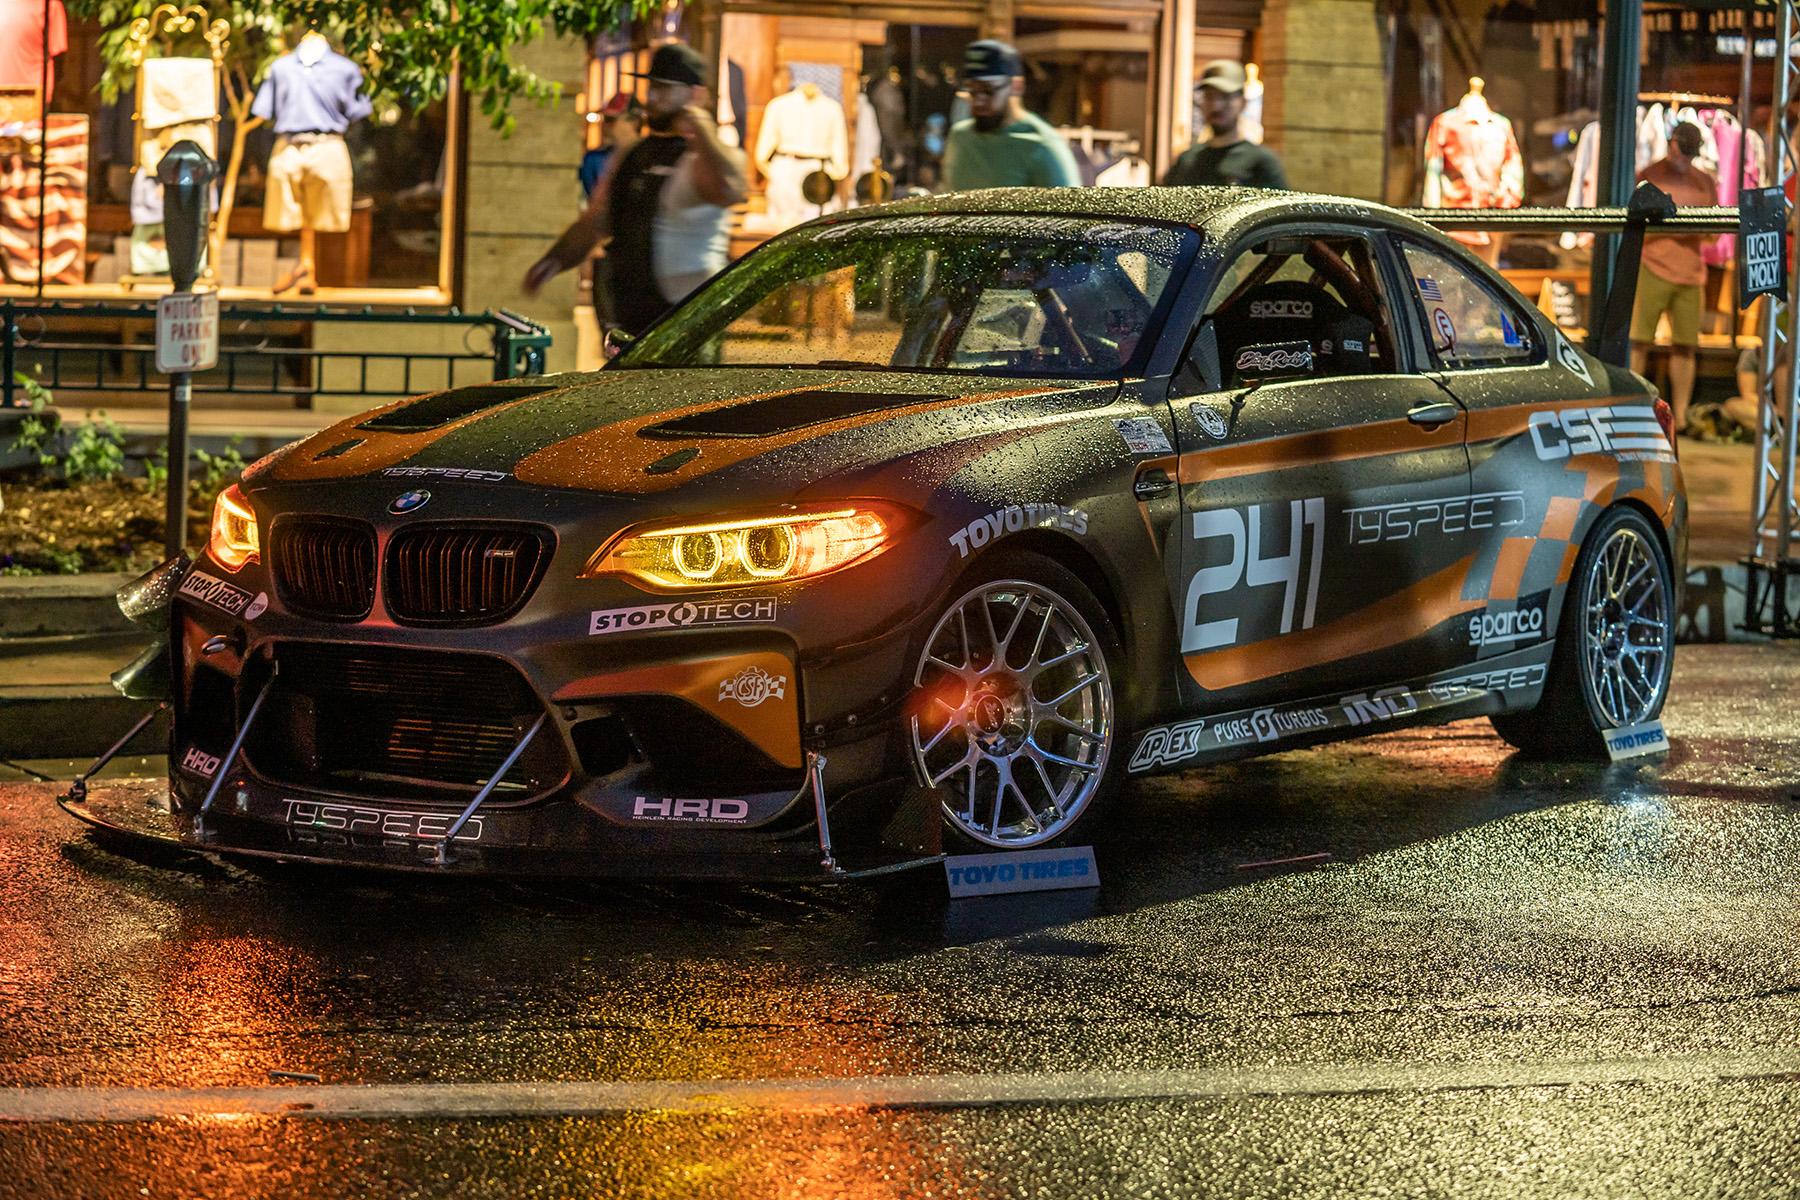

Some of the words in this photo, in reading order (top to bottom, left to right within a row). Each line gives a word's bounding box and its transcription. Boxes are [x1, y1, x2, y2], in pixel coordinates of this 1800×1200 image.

[1749, 235, 1779, 260] LIQUI
[1749, 262, 1779, 288] MOLY
[1250, 300, 1313, 318] sparco
[1528, 406, 1650, 461] CSF
[949, 504, 1025, 558] TOYO
[1023, 501, 1089, 536] TIRES
[1181, 497, 1325, 653] 241
[184, 575, 213, 594] STOP
[214, 587, 250, 612] TECH
[595, 610, 667, 631] STOP
[698, 600, 773, 621] TECH
[1469, 607, 1543, 647] sparco
[736, 676, 766, 698] CSF
[1213, 717, 1254, 743] PURE
[1273, 707, 1330, 732] TURBOS
[1132, 723, 1202, 767] APEX
[1608, 734, 1635, 751] TOYO
[1634, 729, 1664, 747] TIRES
[183, 748, 221, 775] HRD
[633, 796, 749, 819] HRD
[950, 864, 1016, 886] TOYO
[1019, 858, 1089, 880] TIRES
